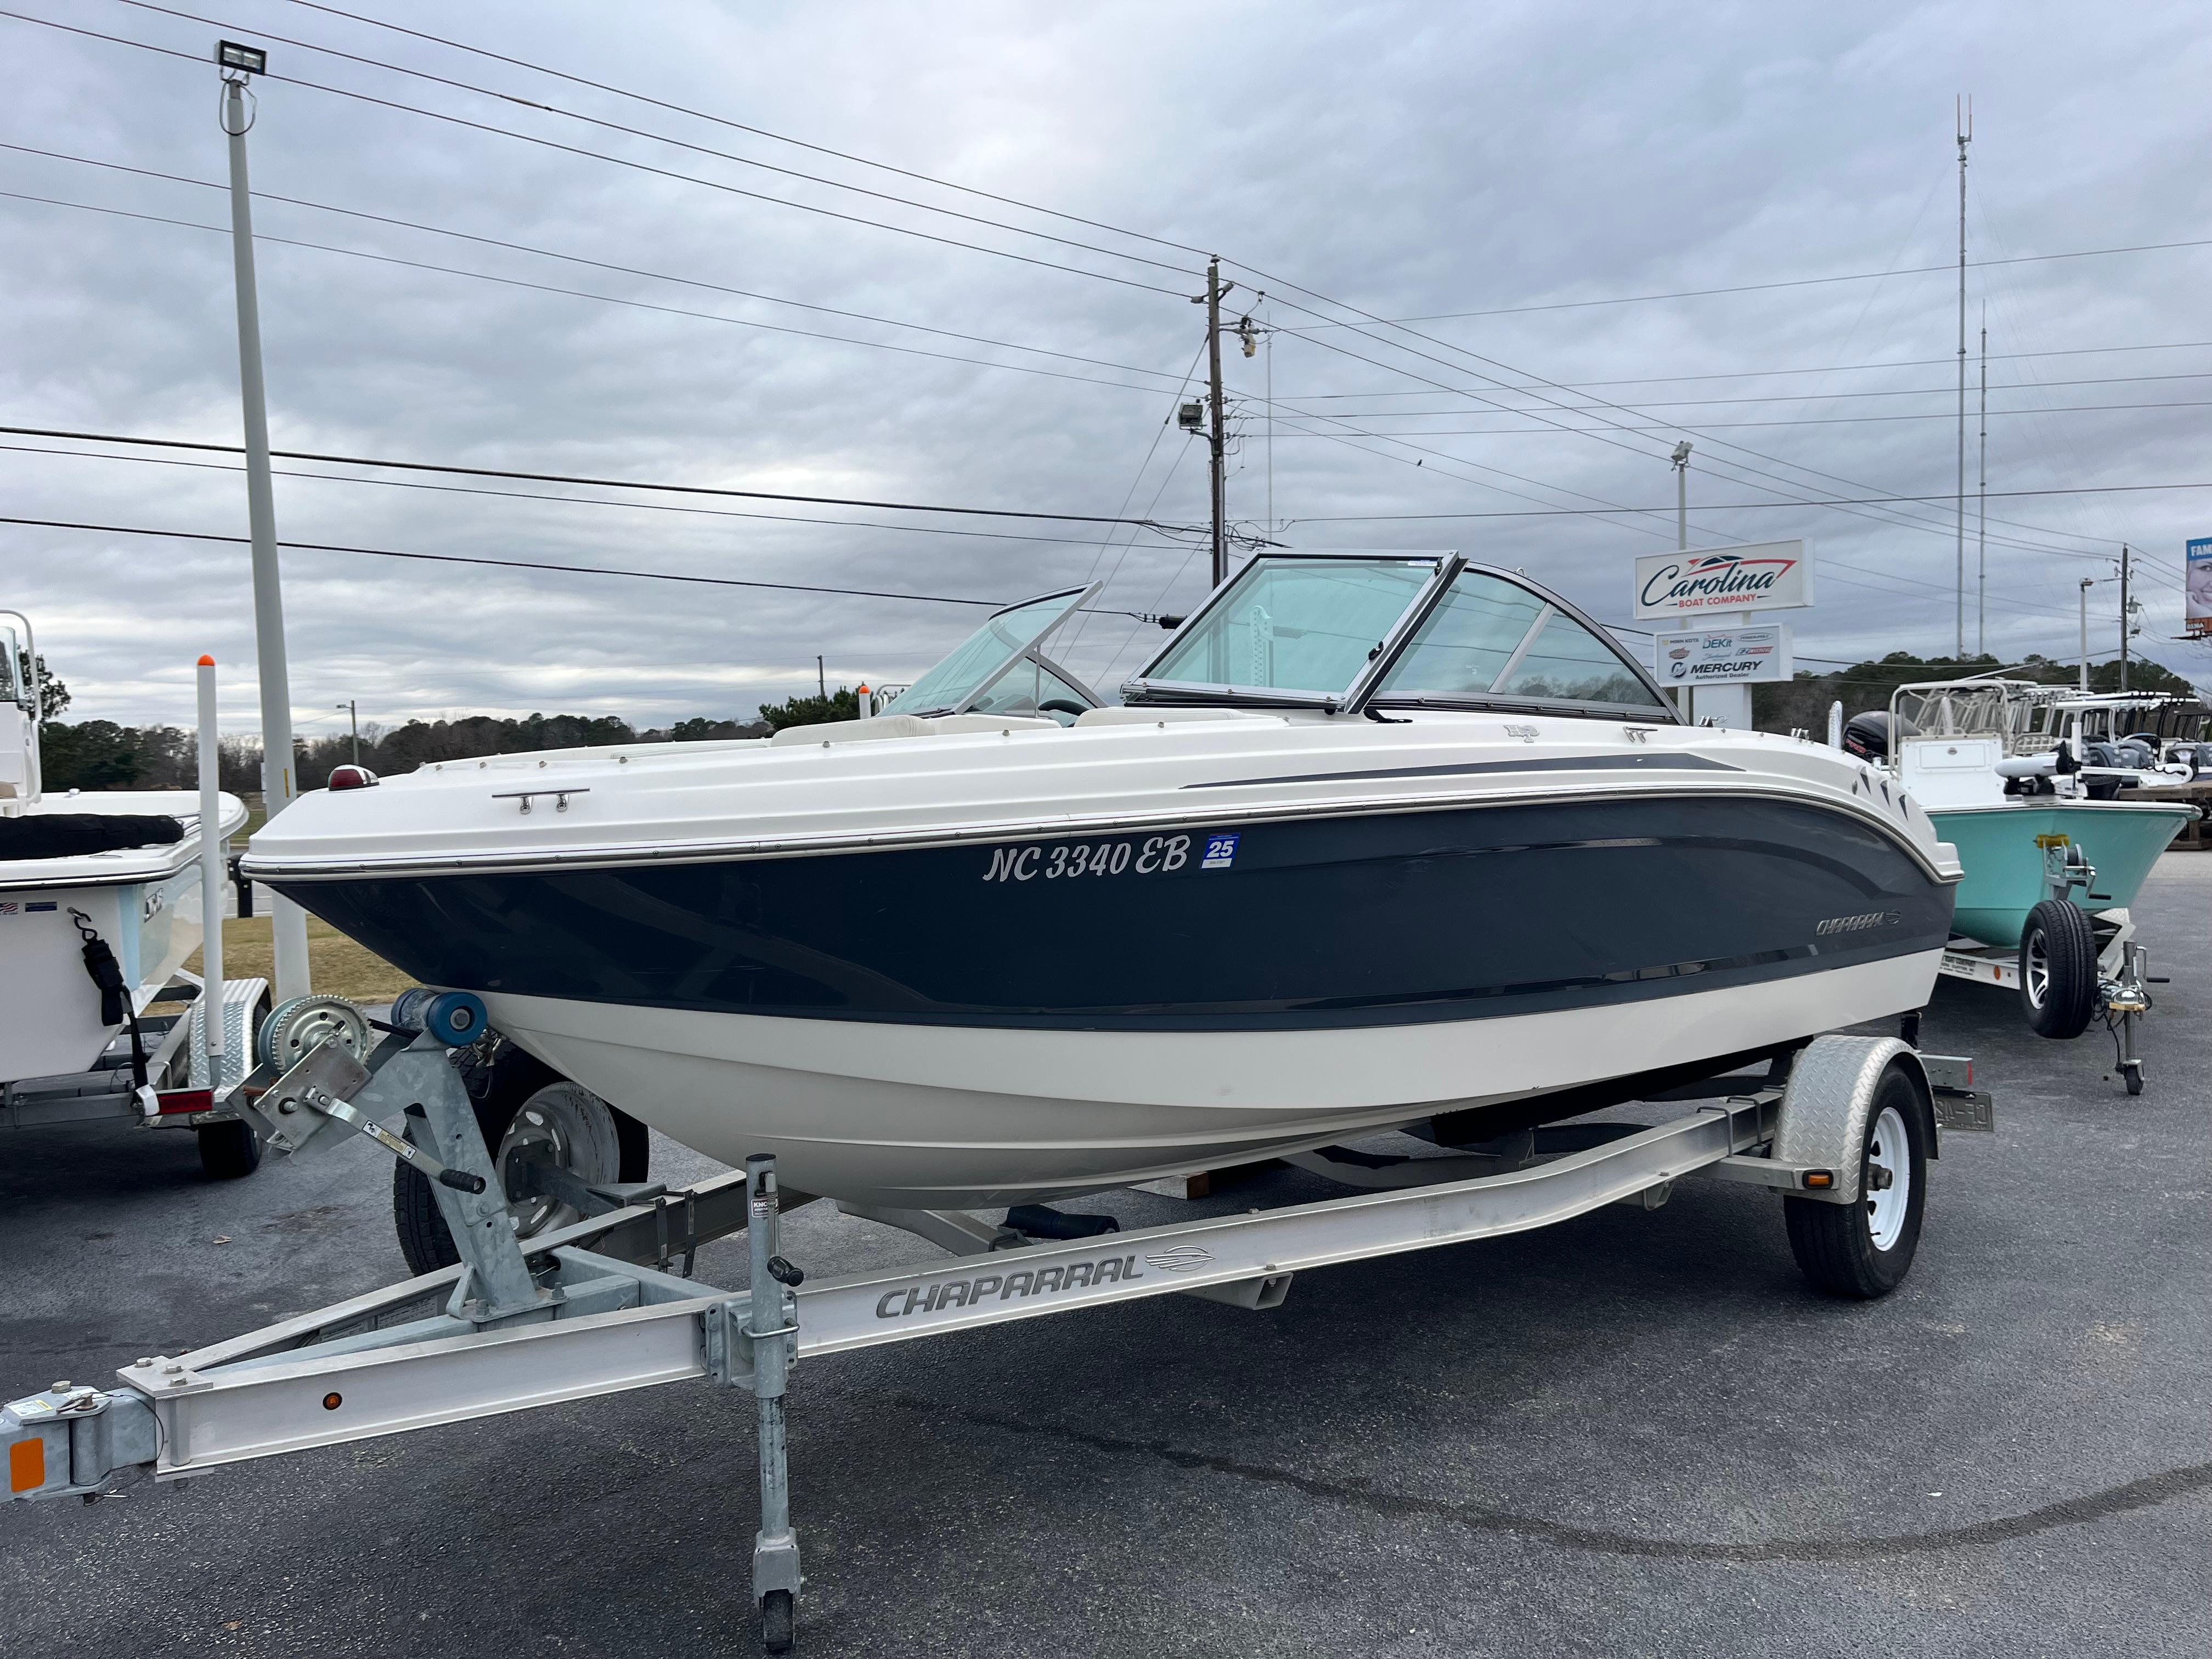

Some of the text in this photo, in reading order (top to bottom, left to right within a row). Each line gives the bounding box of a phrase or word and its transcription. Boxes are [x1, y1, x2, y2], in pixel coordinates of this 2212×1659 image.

[1641, 561, 1776, 606] Carolina
[1679, 594, 1757, 608] BOAT COMPANY
[1690, 661, 1764, 674] MERCURY
[983, 834, 1191, 882] NC 3340 EB
[1206, 840, 1234, 858] 25
[1816, 912, 1886, 936] CHAPARRAL
[876, 1255, 1144, 1318] CHAPARRAL
